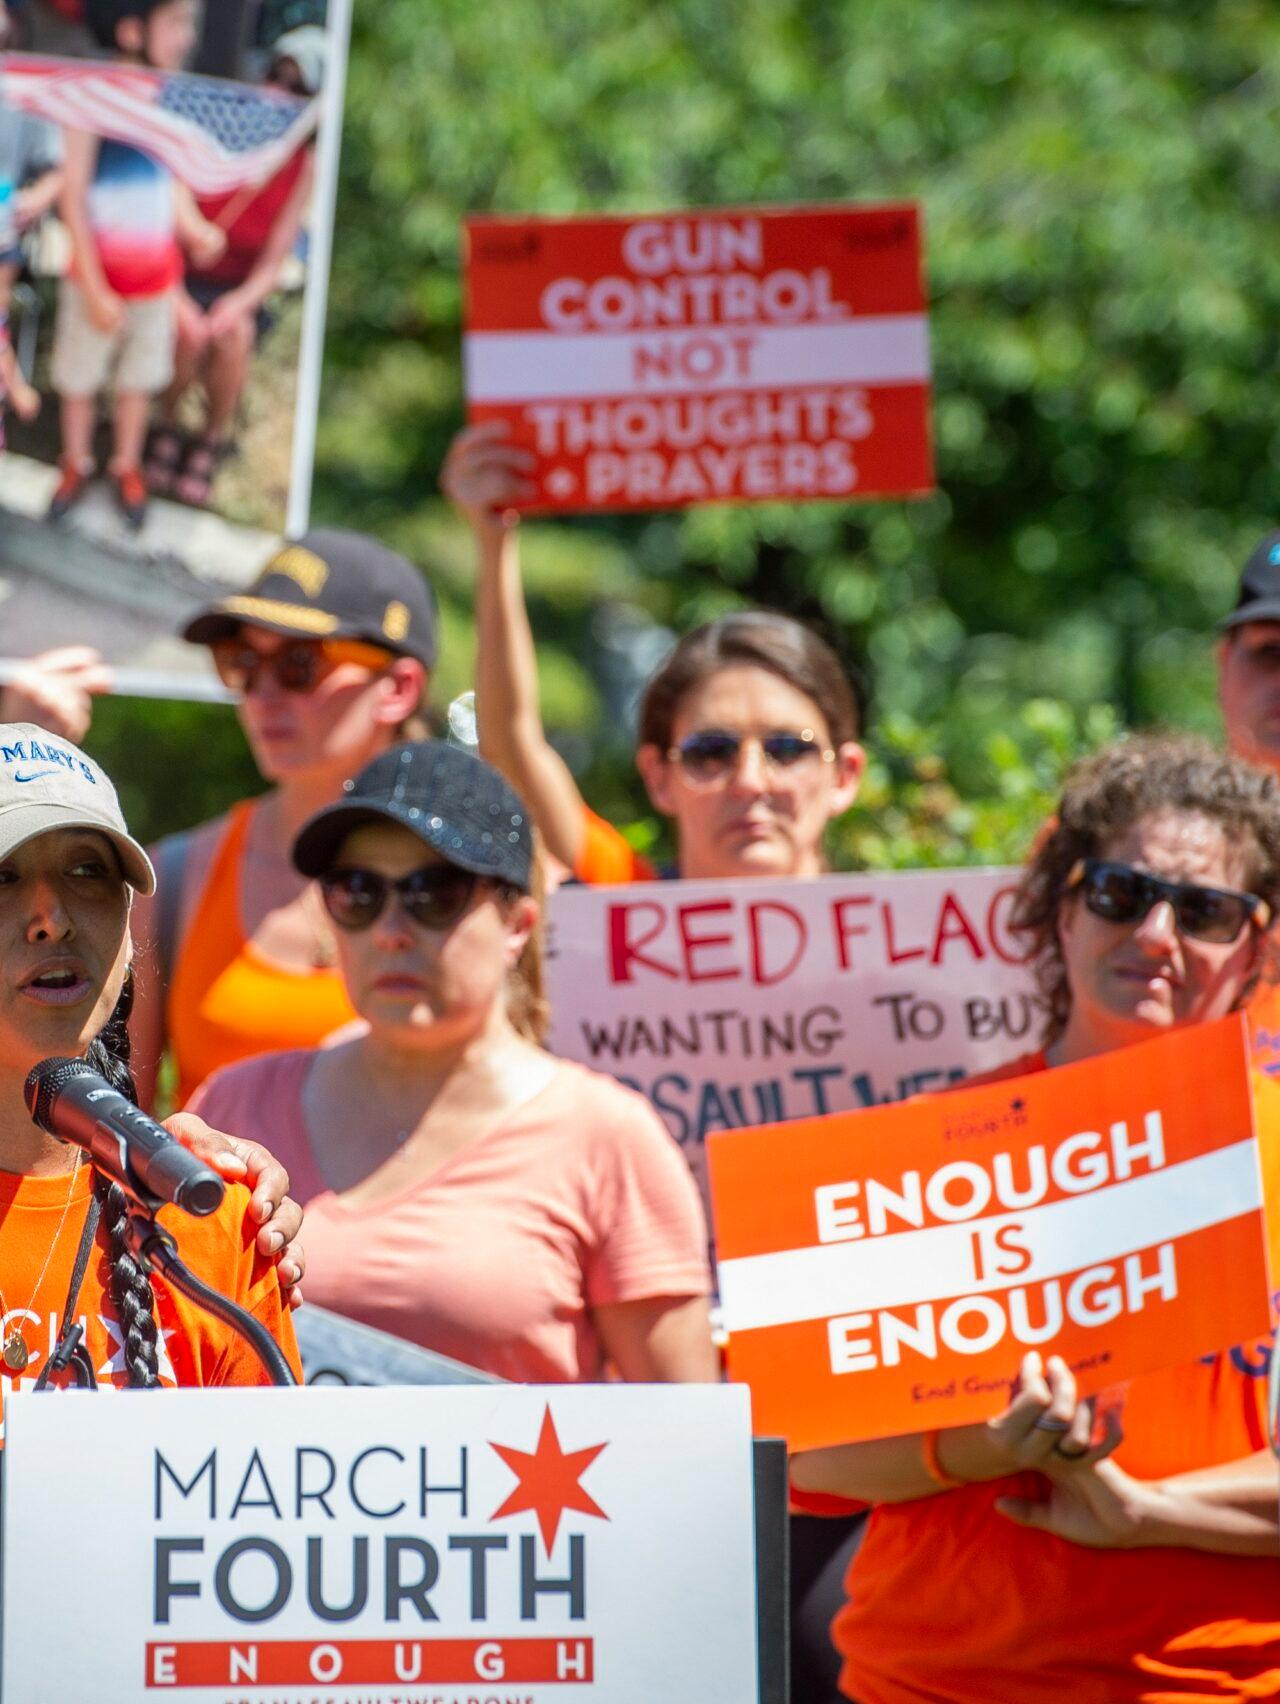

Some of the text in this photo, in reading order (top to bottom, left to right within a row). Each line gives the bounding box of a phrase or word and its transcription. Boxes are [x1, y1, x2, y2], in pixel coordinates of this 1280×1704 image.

[624, 219, 764, 276] GUN
[540, 269, 848, 331] CONTROL
[634, 337, 757, 382] NOT
[526, 391, 872, 454] THOUGHTS
[585, 441, 856, 502] PRAYERS
[605, 899, 808, 985] RED
[581, 1008, 845, 1060] WANTING
[873, 994, 944, 1044] TO
[814, 1110, 1166, 1244] ENOUGH
[971, 1224, 1033, 1282] IS
[827, 1243, 1179, 1376] ENOUGH
[153, 1446, 469, 1520] MARCH
[153, 1533, 585, 1624] FOURTH
[153, 1642, 587, 1683] ENOUGH
